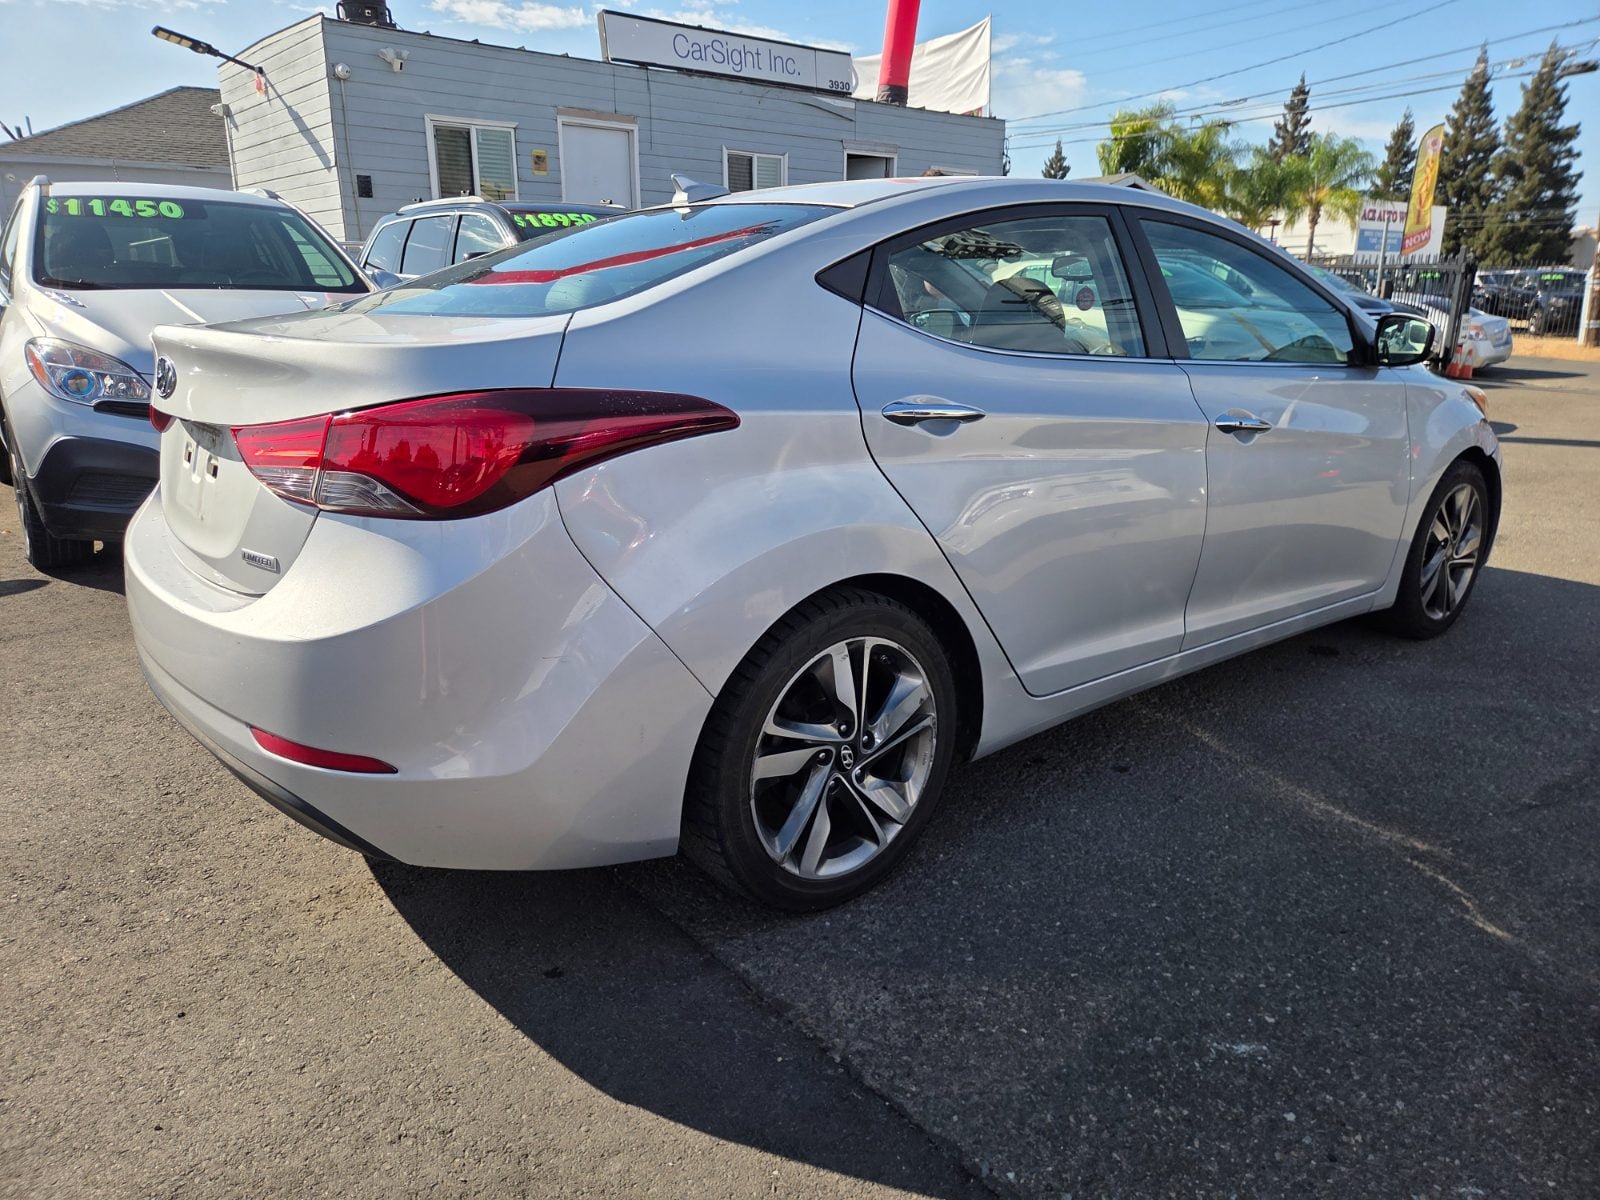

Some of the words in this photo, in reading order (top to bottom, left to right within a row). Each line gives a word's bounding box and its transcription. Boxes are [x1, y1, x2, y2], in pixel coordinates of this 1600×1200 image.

[673, 33, 762, 73] CarSight
[769, 48, 801, 76] Inc.
[828, 79, 851, 91] 3930
[46, 198, 185, 219] $11450
[1405, 229, 1431, 248] NOW
[242, 551, 272, 567] LIMITED
